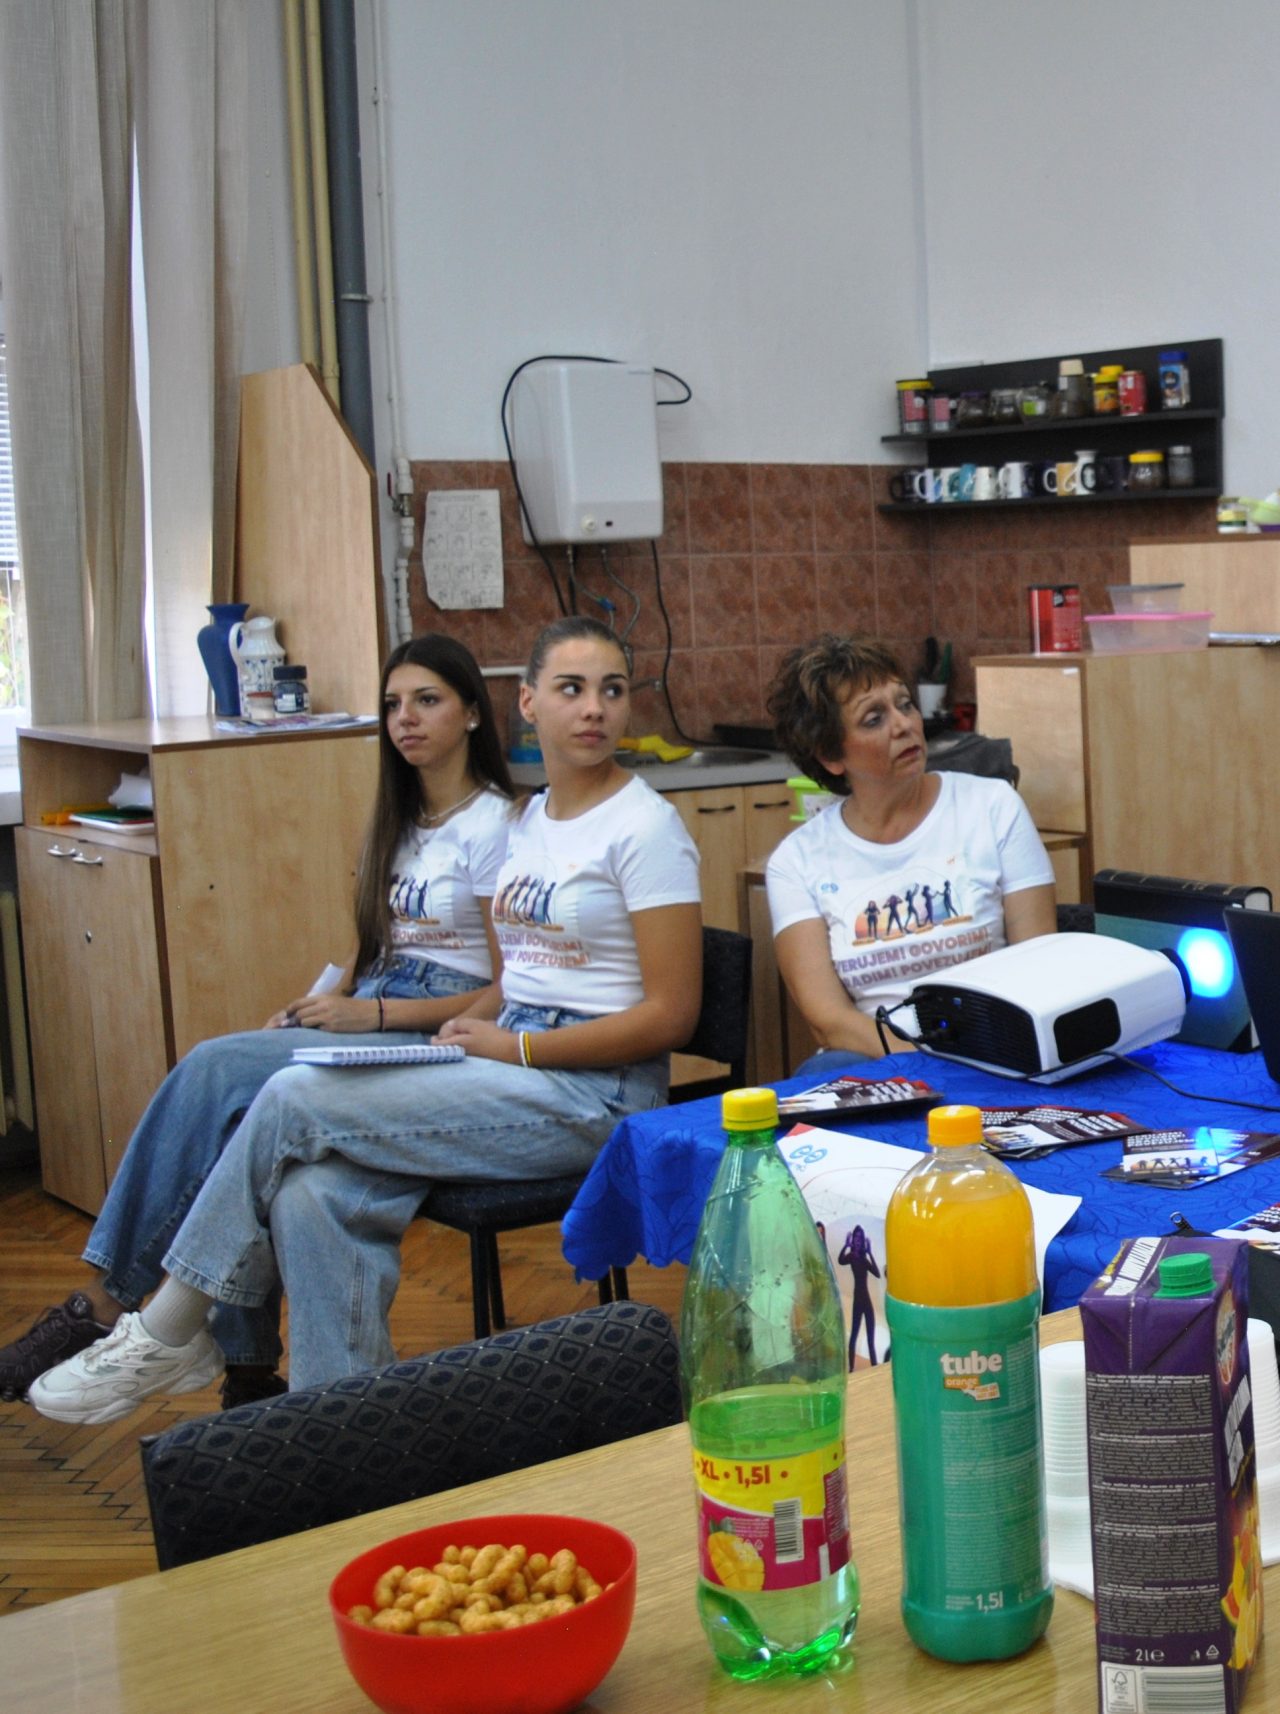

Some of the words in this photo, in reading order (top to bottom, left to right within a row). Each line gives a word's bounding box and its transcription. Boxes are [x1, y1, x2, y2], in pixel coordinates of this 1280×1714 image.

[909, 927, 989, 957] GOVORIM!
[940, 1350, 1002, 1375] tube
[700, 1457, 720, 1481] XL
[735, 1464, 771, 1488] 1,5l
[976, 1590, 1003, 1615] 1,5l
